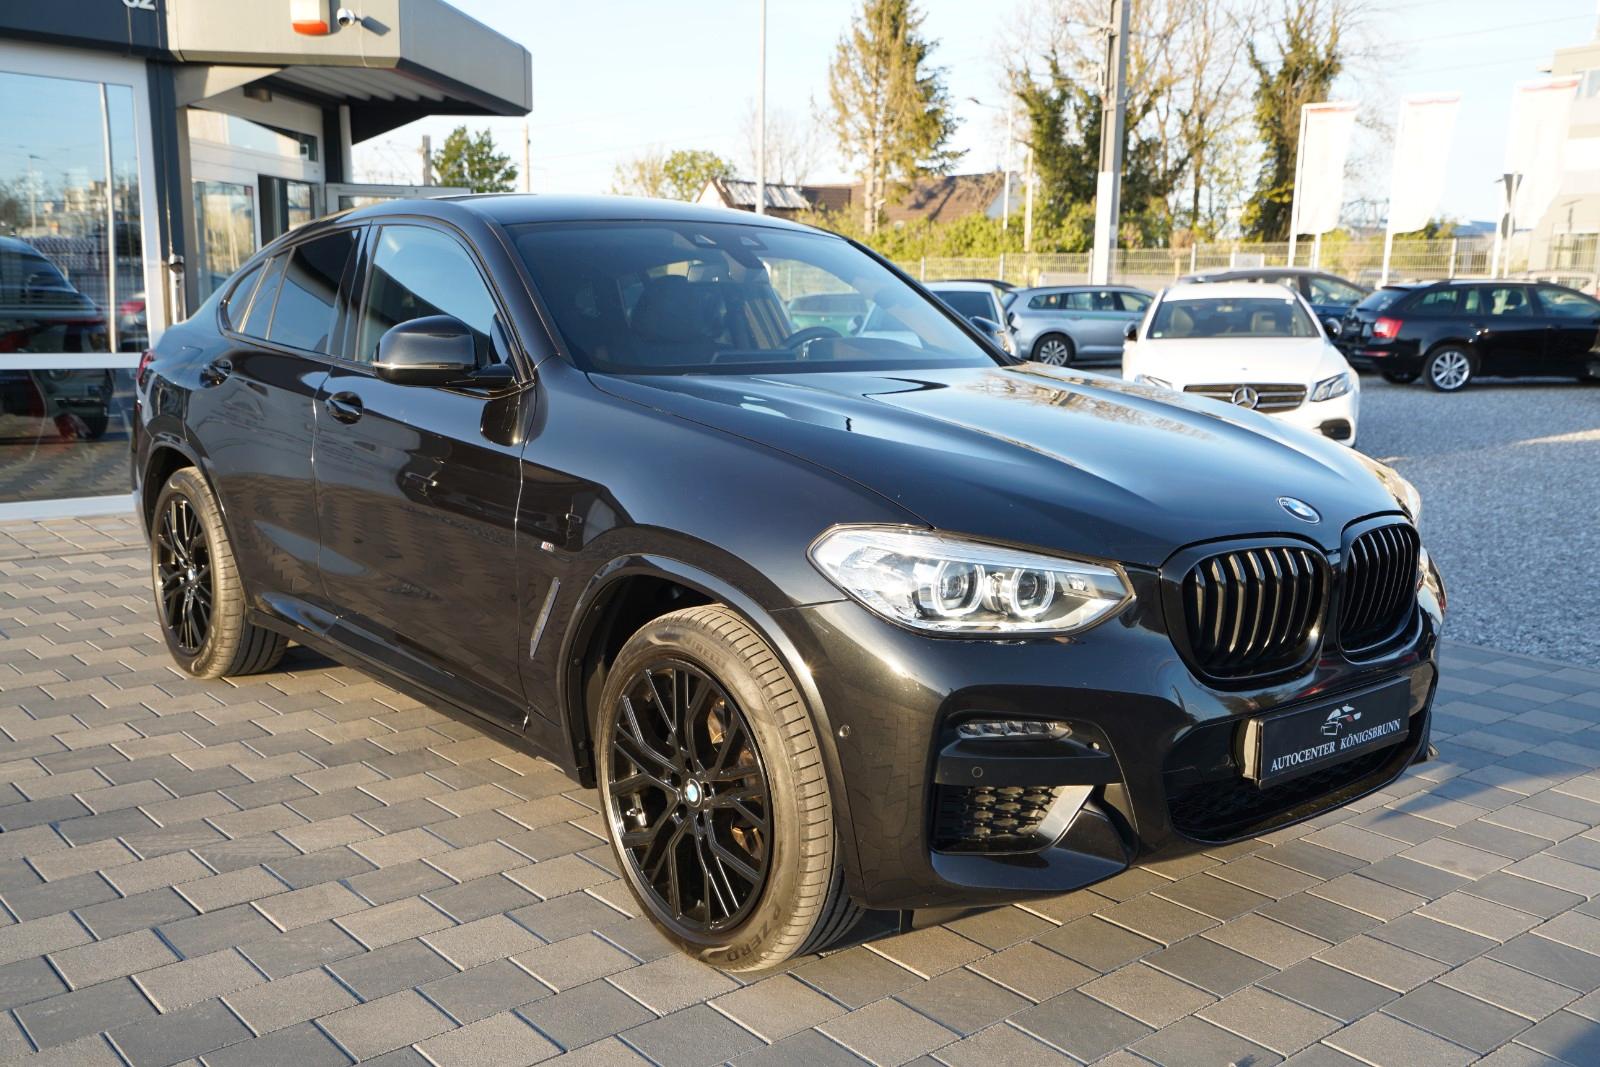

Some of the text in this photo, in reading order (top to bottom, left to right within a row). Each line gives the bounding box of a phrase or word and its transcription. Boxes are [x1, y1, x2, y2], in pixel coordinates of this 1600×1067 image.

[1271, 718, 1401, 772] AUTOCENTER KÖNIGSBRUNN
[727, 919, 773, 962] ZERO
